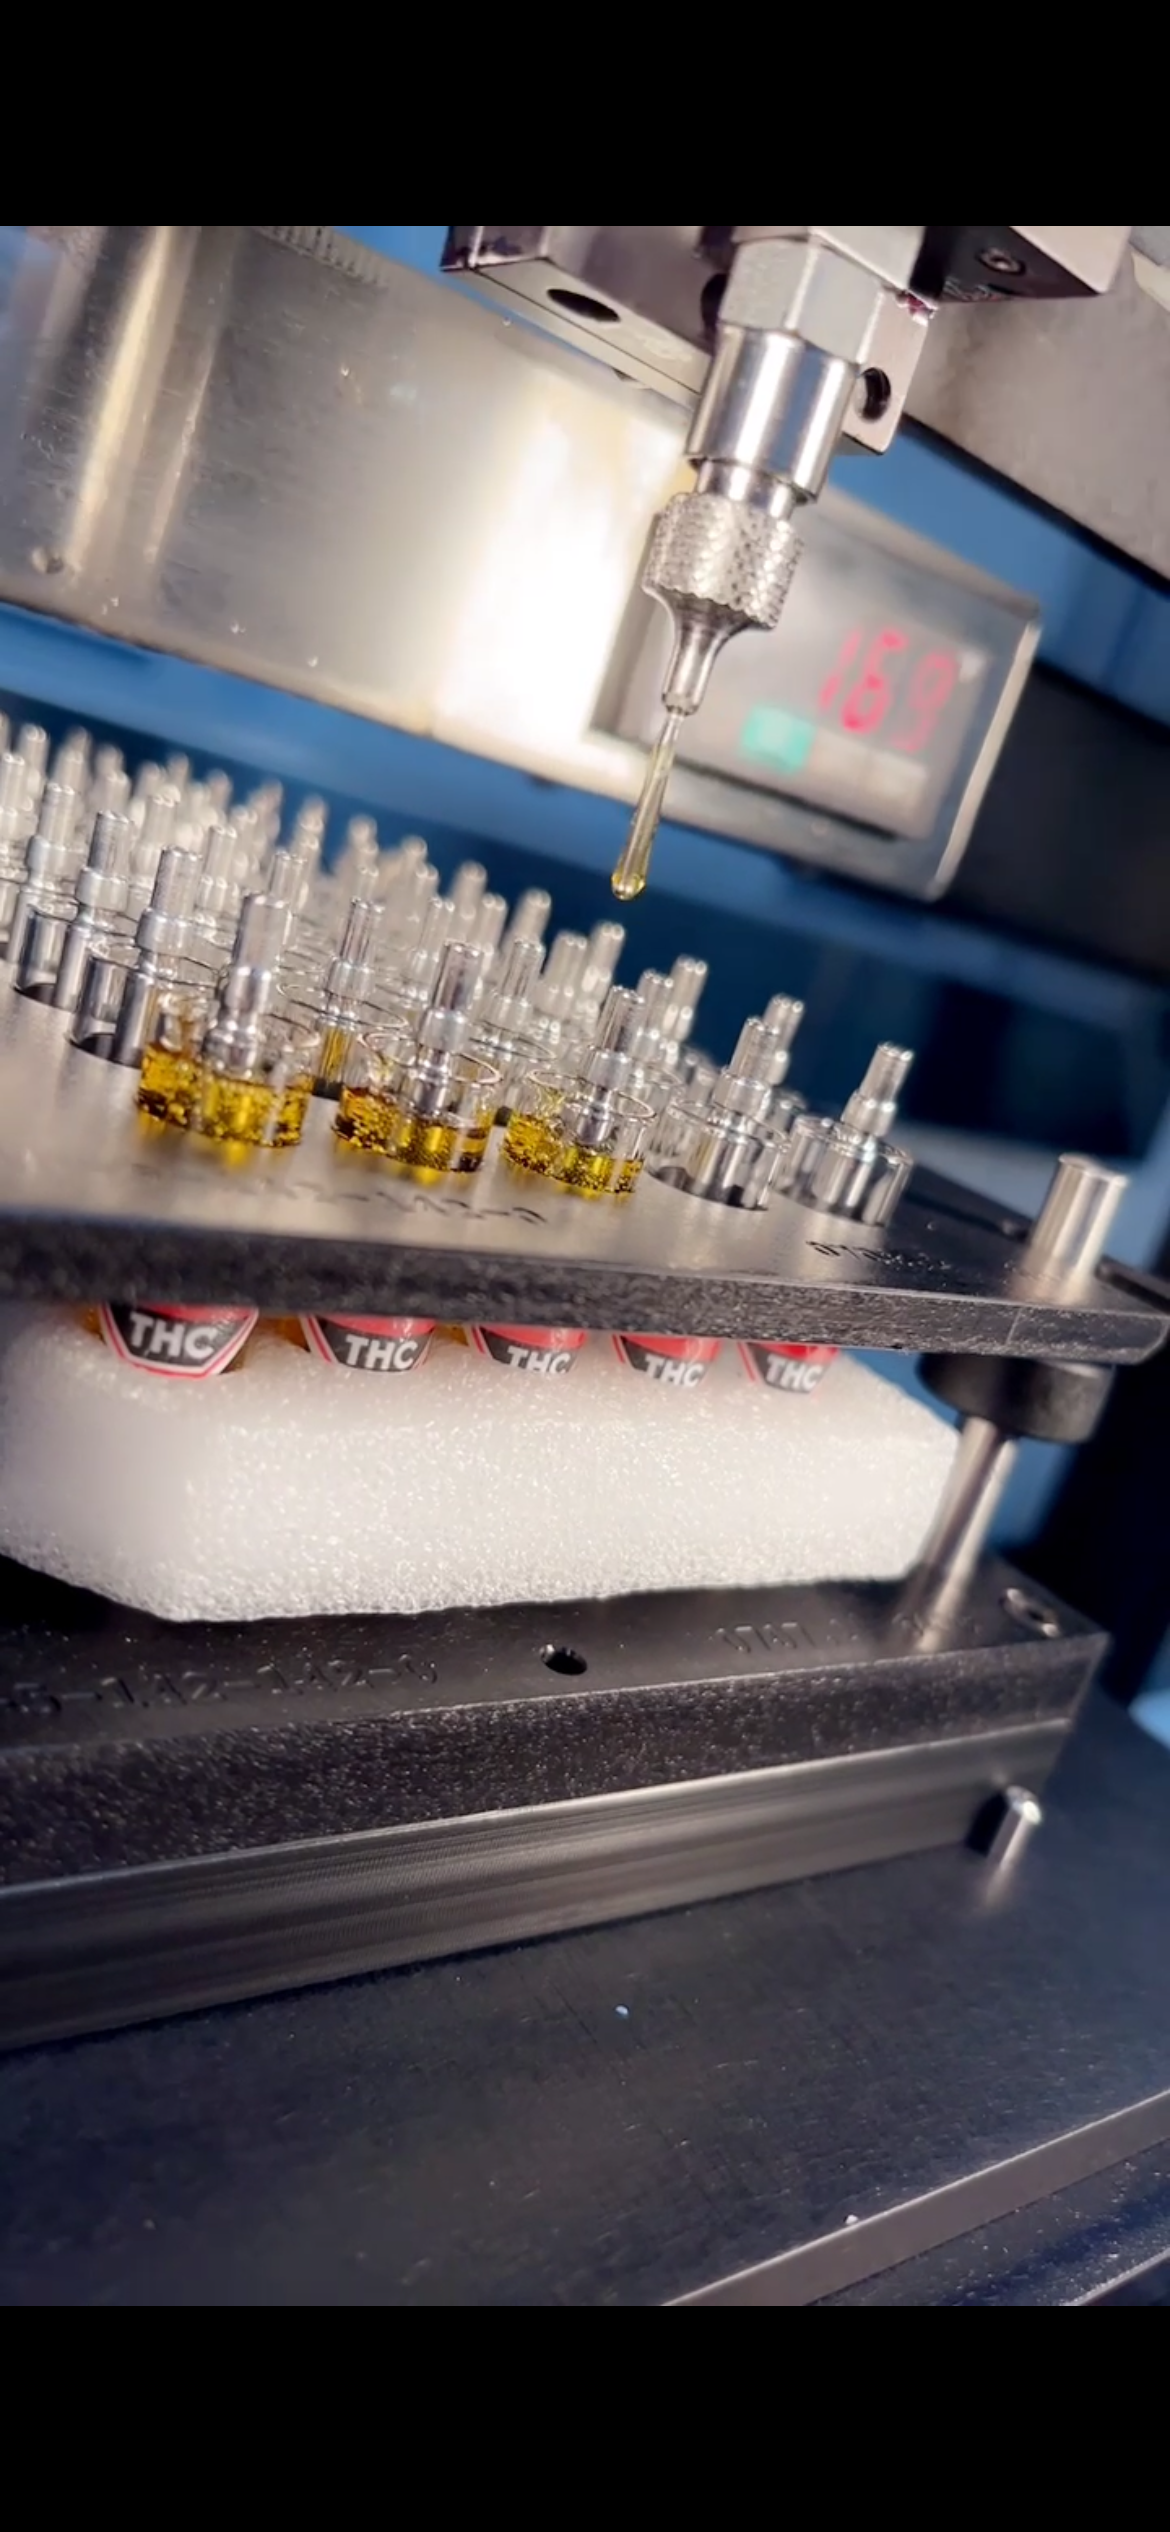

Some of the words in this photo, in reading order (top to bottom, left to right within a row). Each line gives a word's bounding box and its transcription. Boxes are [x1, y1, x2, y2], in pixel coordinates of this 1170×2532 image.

[130, 1311, 218, 1360] THC
[345, 1334, 418, 1371] THC
[507, 1345, 570, 1375] THC
[645, 1353, 704, 1388] THC
[766, 1354, 825, 1391] THC
